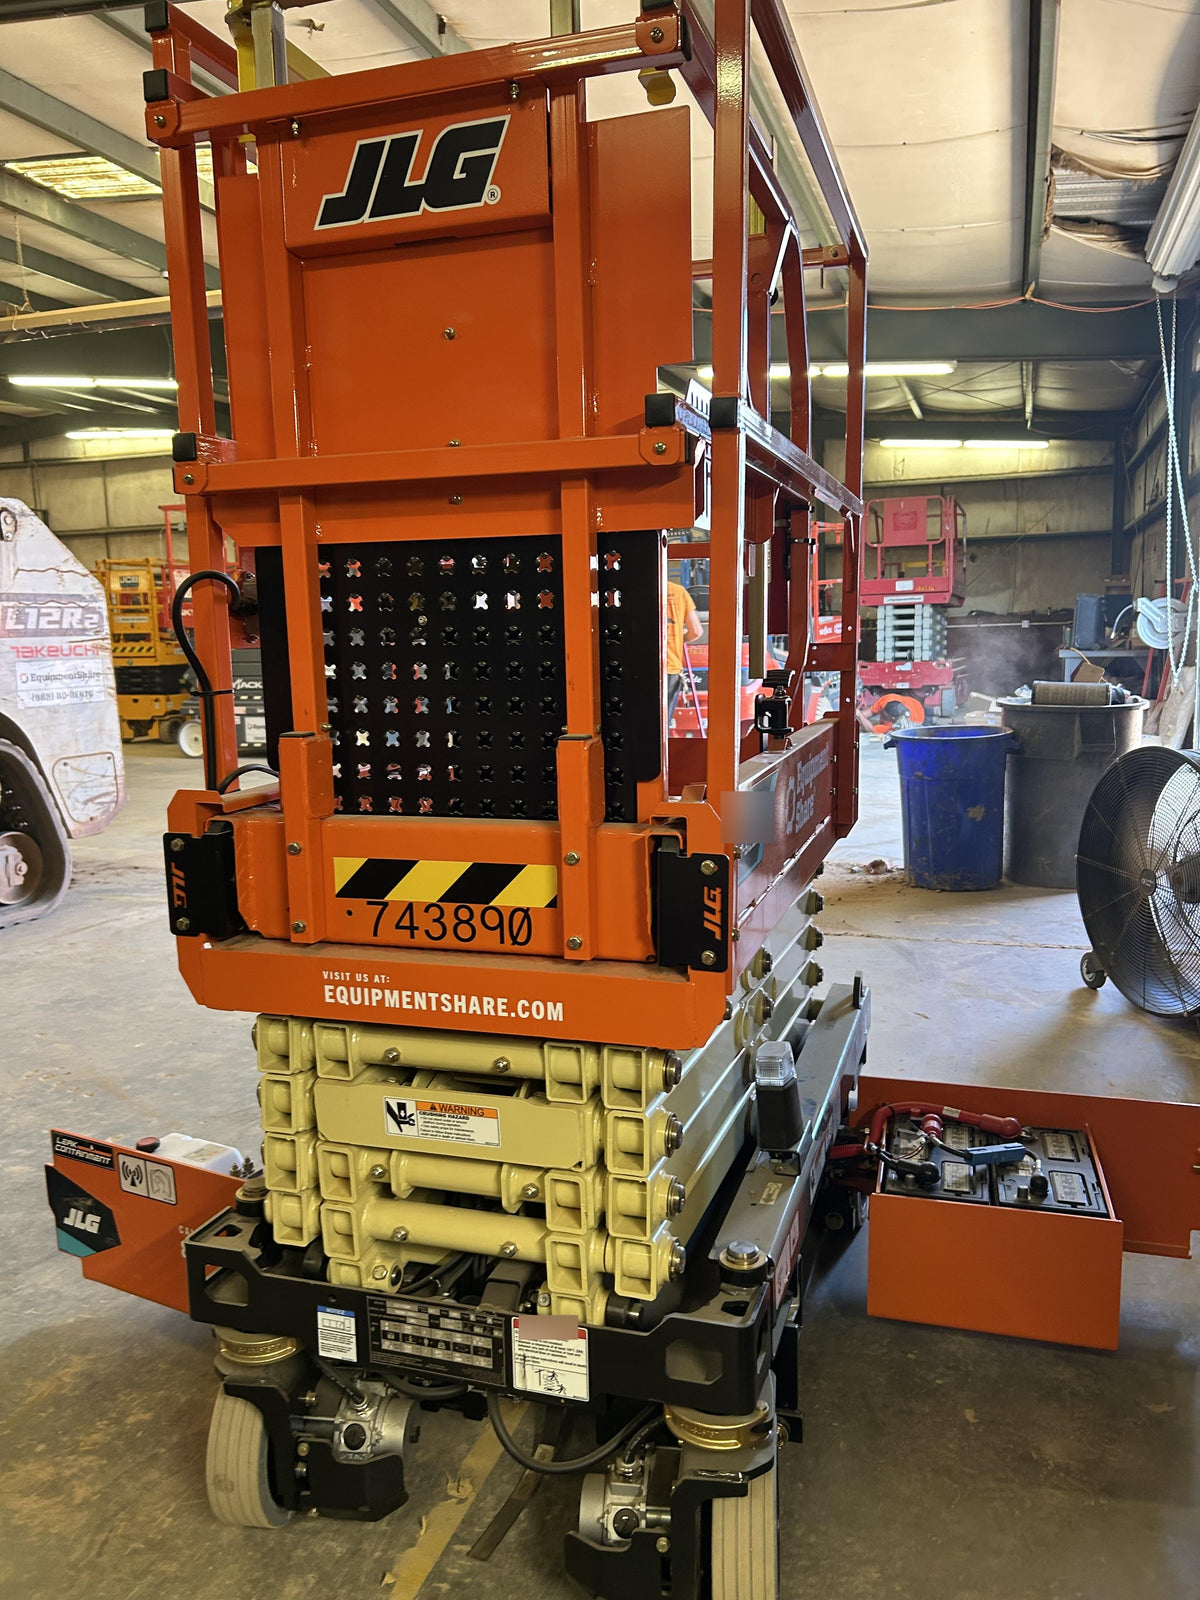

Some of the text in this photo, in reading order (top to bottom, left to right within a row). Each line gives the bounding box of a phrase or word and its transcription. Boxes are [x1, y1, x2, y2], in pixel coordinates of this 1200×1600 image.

[171, 862, 187, 908] JLG
[366, 900, 533, 947] 743890
[703, 886, 722, 941] JLG
[322, 970, 391, 983] VISIT US AT:
[324, 984, 564, 1022] EQUIPMENTSHARE.COM
[438, 1103, 485, 1117] WARNING
[54, 1144, 112, 1165] CONTAINMENT
[55, 1136, 79, 1149] LEAK
[62, 1207, 102, 1234] JLG
